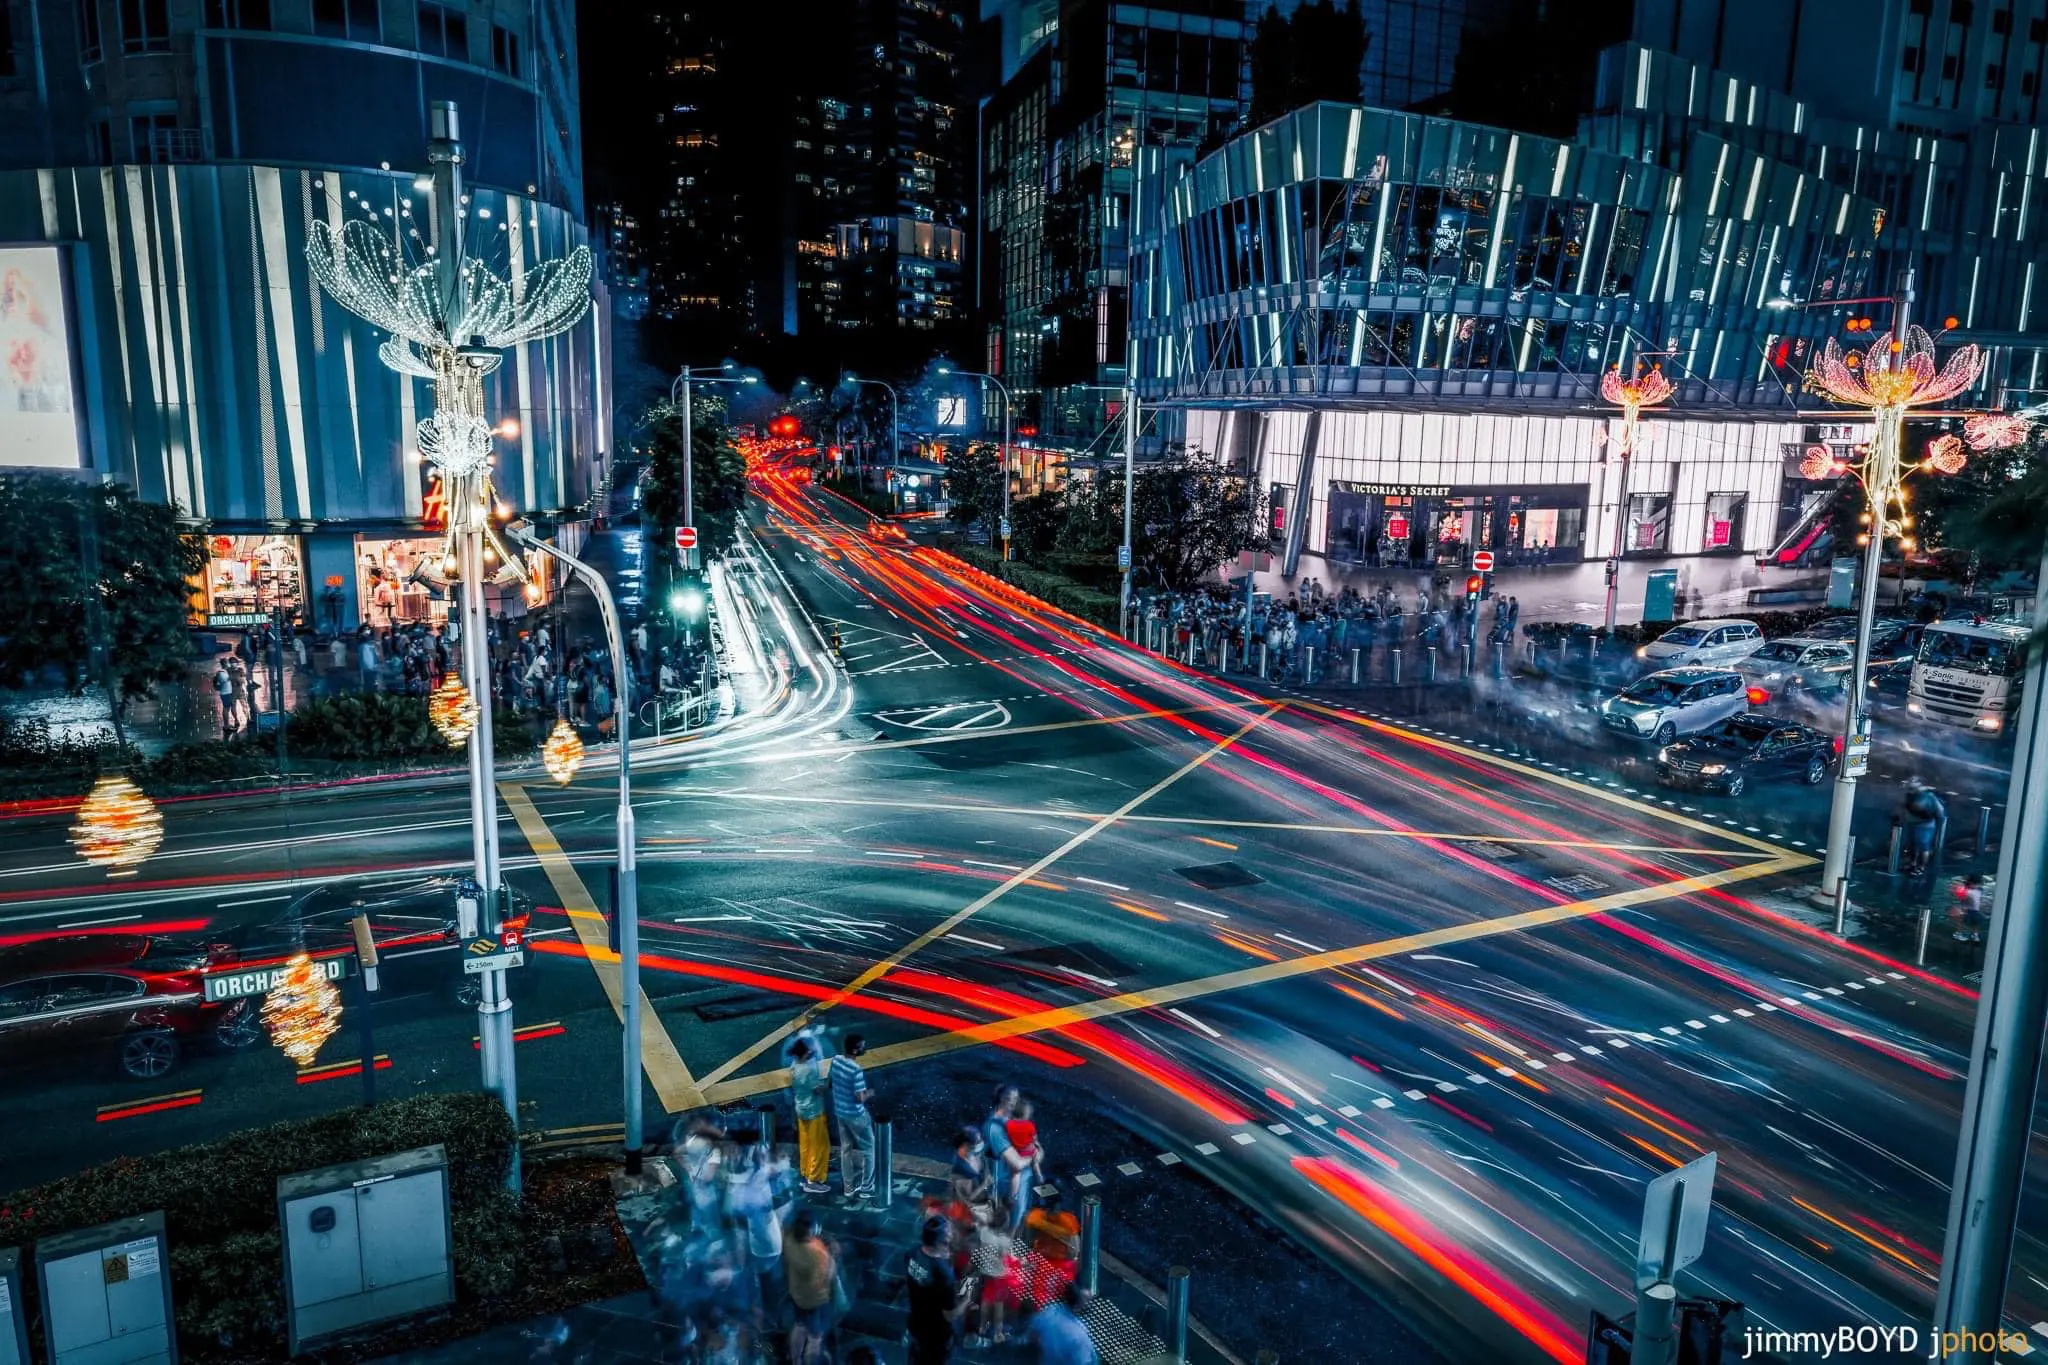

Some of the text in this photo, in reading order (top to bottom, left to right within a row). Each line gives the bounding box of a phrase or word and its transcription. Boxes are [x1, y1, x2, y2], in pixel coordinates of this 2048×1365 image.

[1351, 483, 1450, 496] VICTORIA'S SECRET
[210, 614, 267, 625] ORCHARD RD
[504, 945, 519, 953] MRT
